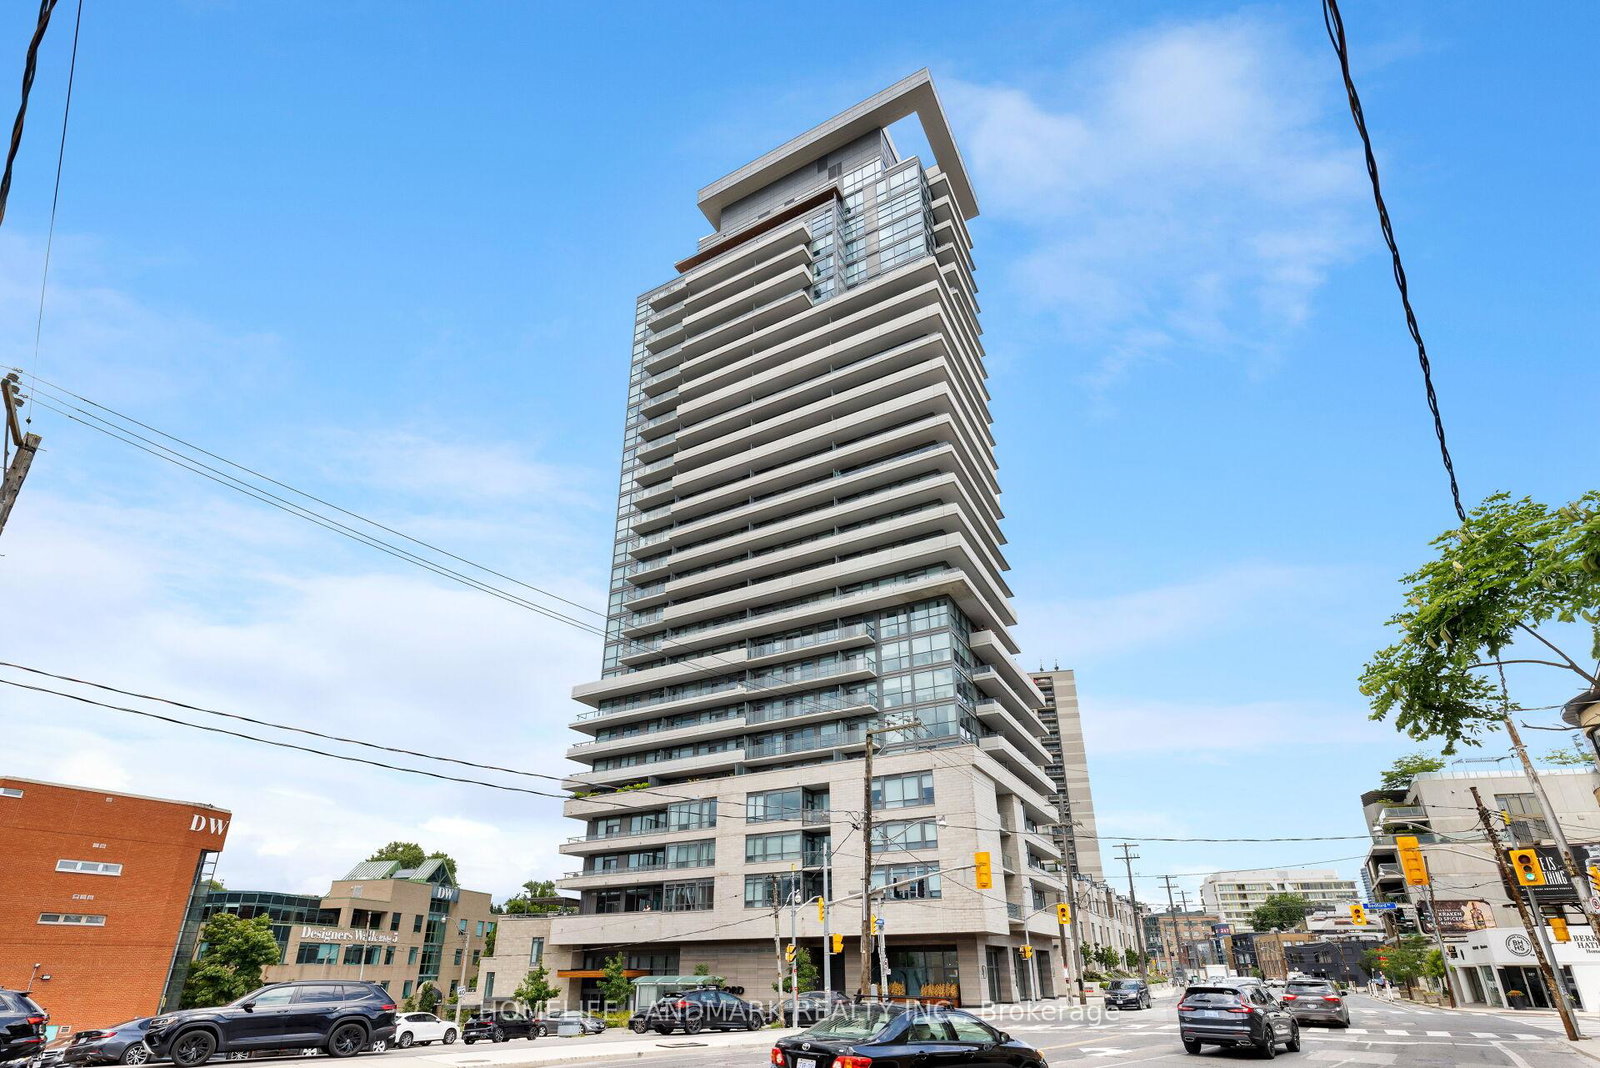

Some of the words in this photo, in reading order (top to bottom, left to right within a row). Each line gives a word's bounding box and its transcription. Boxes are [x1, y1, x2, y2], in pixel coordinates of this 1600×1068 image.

[190, 814, 230, 836] DW
[1546, 856, 1556, 871] IS
[1543, 871, 1568, 885] THING
[437, 887, 454, 899] DW
[301, 926, 353, 943] Designers
[355, 929, 377, 941] Walk
